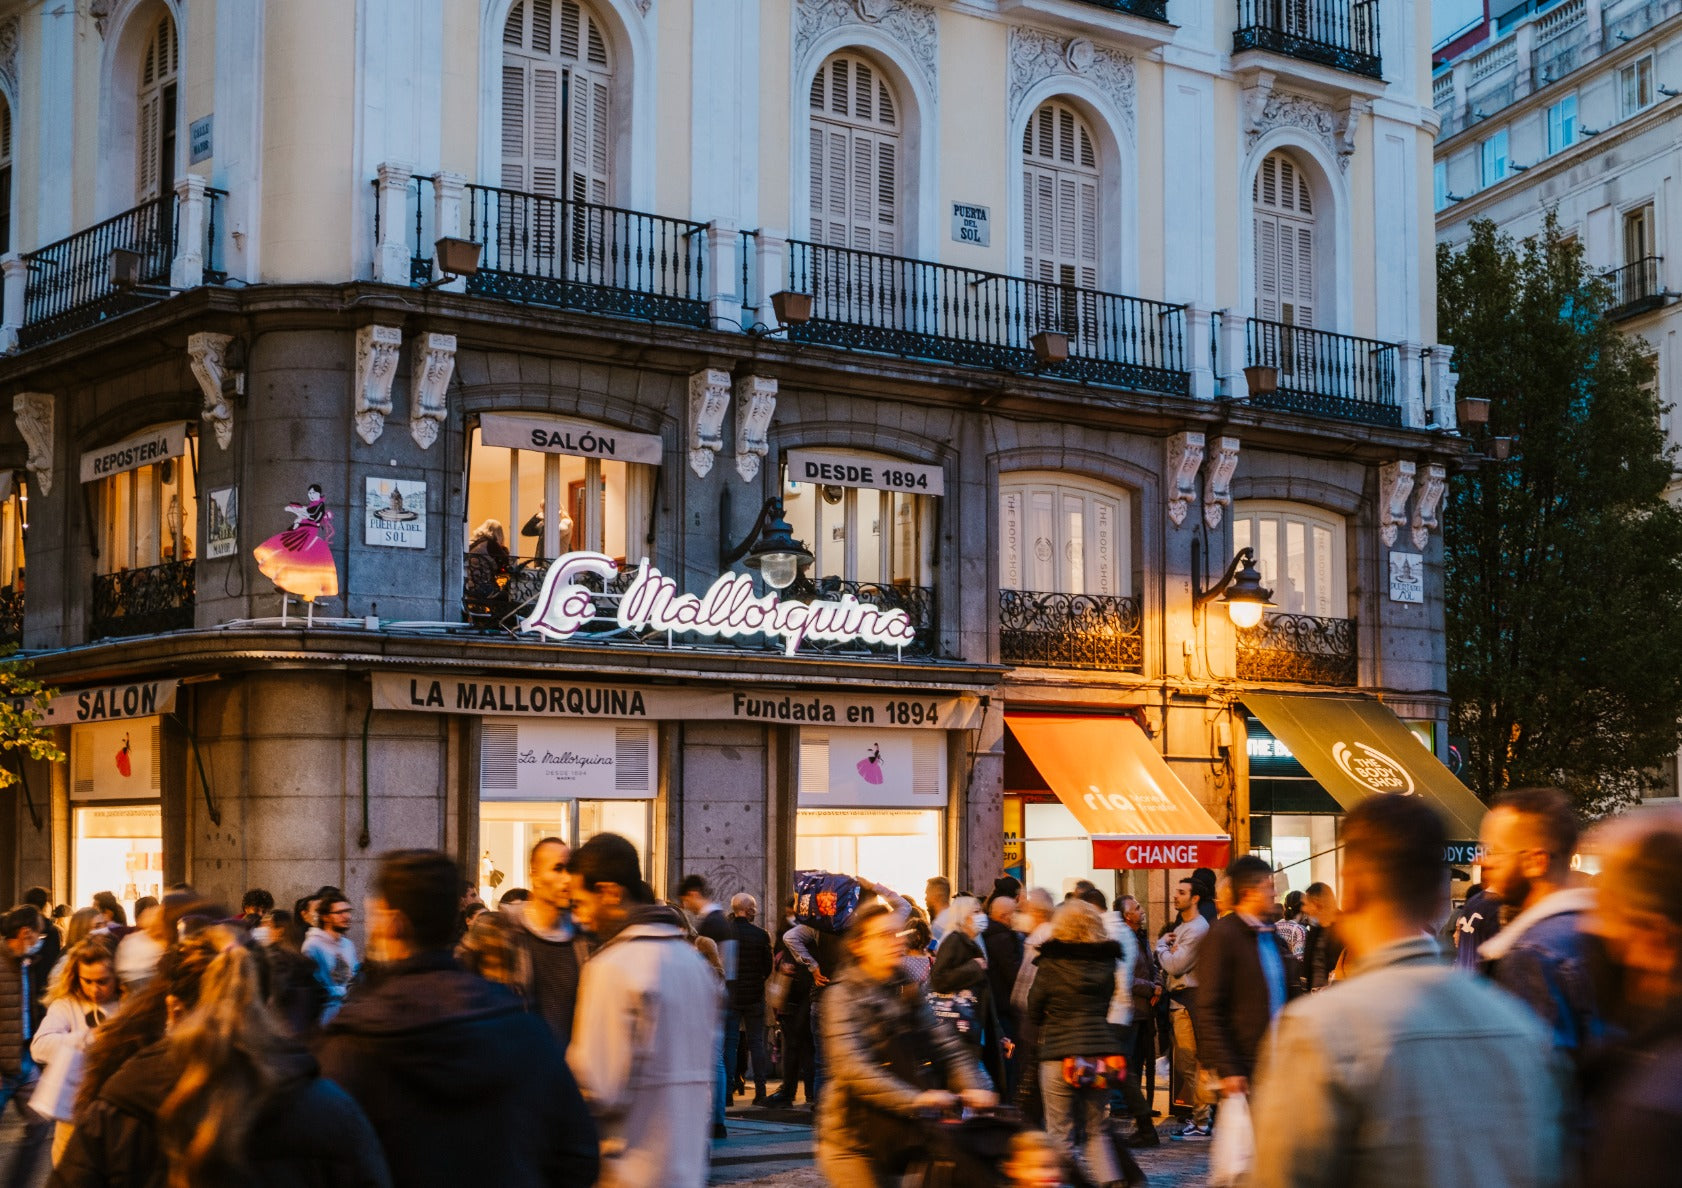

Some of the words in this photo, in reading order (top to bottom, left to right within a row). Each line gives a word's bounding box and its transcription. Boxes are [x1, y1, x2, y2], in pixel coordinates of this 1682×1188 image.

[954, 204, 987, 221] PUERTA
[964, 218, 978, 228] DEL
[960, 227, 981, 242] SOL
[531, 429, 615, 455] SALÓN
[94, 435, 168, 475] REPOSTERÍA
[805, 462, 873, 483] DESDE
[882, 470, 928, 489] 1894
[1008, 494, 1016, 517] THE
[369, 519, 405, 531] PUERTA
[406, 523, 422, 532] DEL
[1008, 520, 1017, 552] BODY
[385, 531, 407, 542] SOL
[1009, 554, 1017, 586] SHOP
[521, 551, 617, 640] La
[617, 556, 916, 657] Mallorquina
[76, 682, 158, 721] SALON
[410, 679, 445, 708] LA
[456, 682, 647, 716] MALLORQUINA
[733, 691, 836, 722] Fundada
[846, 704, 874, 723] en
[886, 701, 939, 725] 1894
[518, 749, 536, 764] La
[541, 749, 614, 769] Mallorquina
[1353, 758, 1382, 768] THE
[1355, 767, 1397, 778] BODY
[1367, 777, 1404, 788] SHOP
[1083, 785, 1136, 811] ria
[1125, 845, 1199, 864] CHANGE
